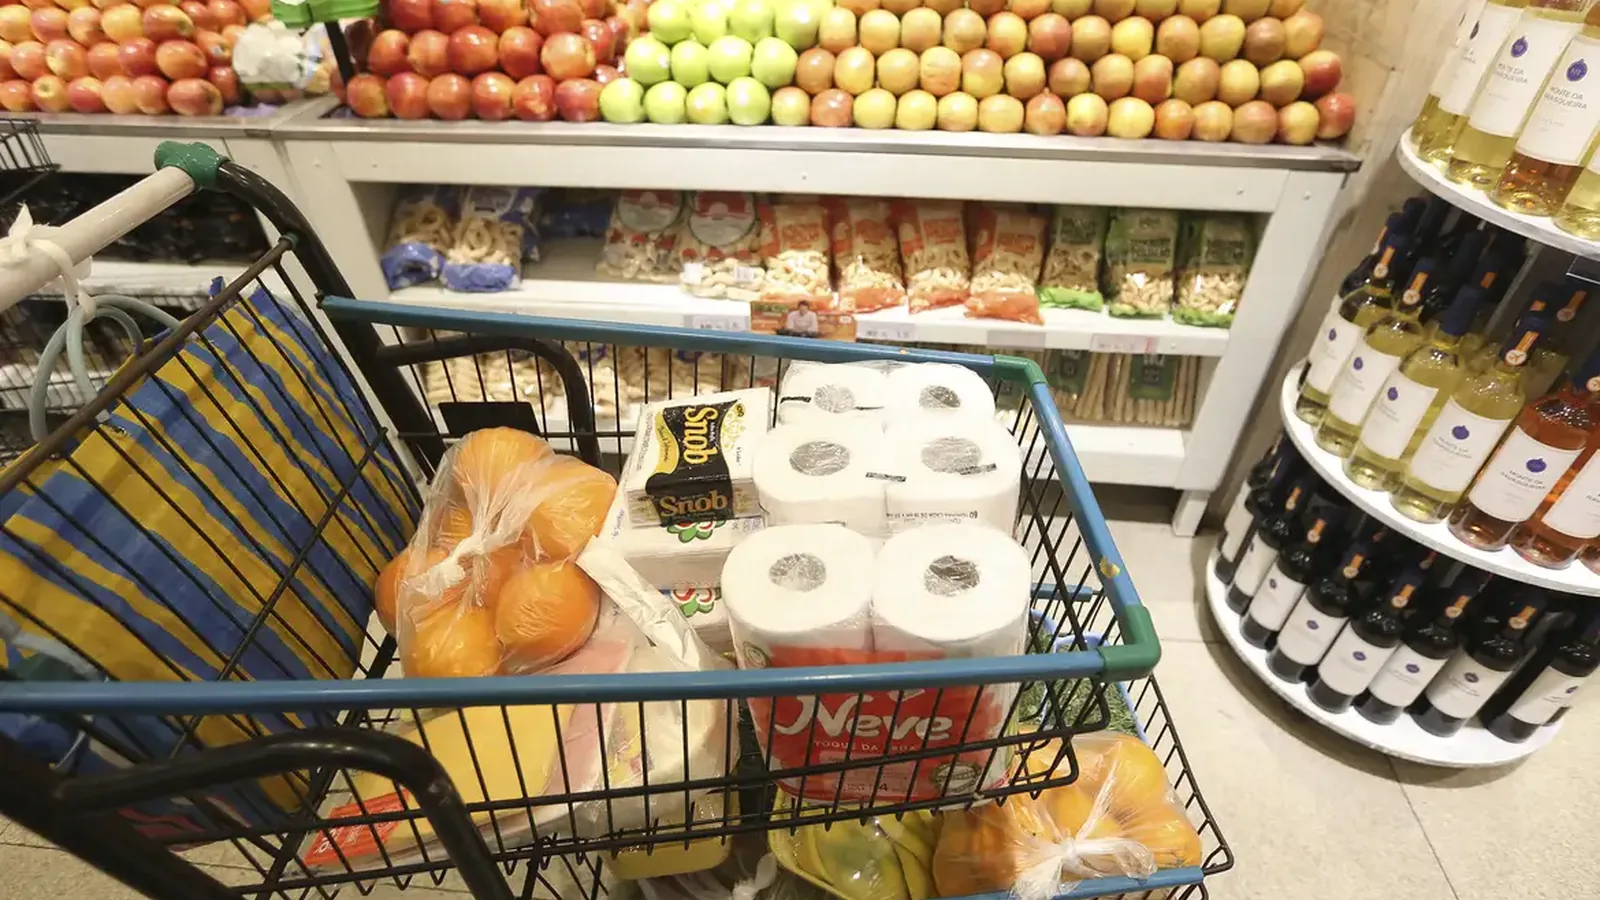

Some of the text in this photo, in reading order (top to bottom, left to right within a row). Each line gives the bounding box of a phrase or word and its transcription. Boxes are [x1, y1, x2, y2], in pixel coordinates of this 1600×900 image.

[683, 406, 719, 464] Snob
[660, 490, 728, 517] Snob
[775, 694, 953, 741] Neve
[861, 743, 879, 751] DA
